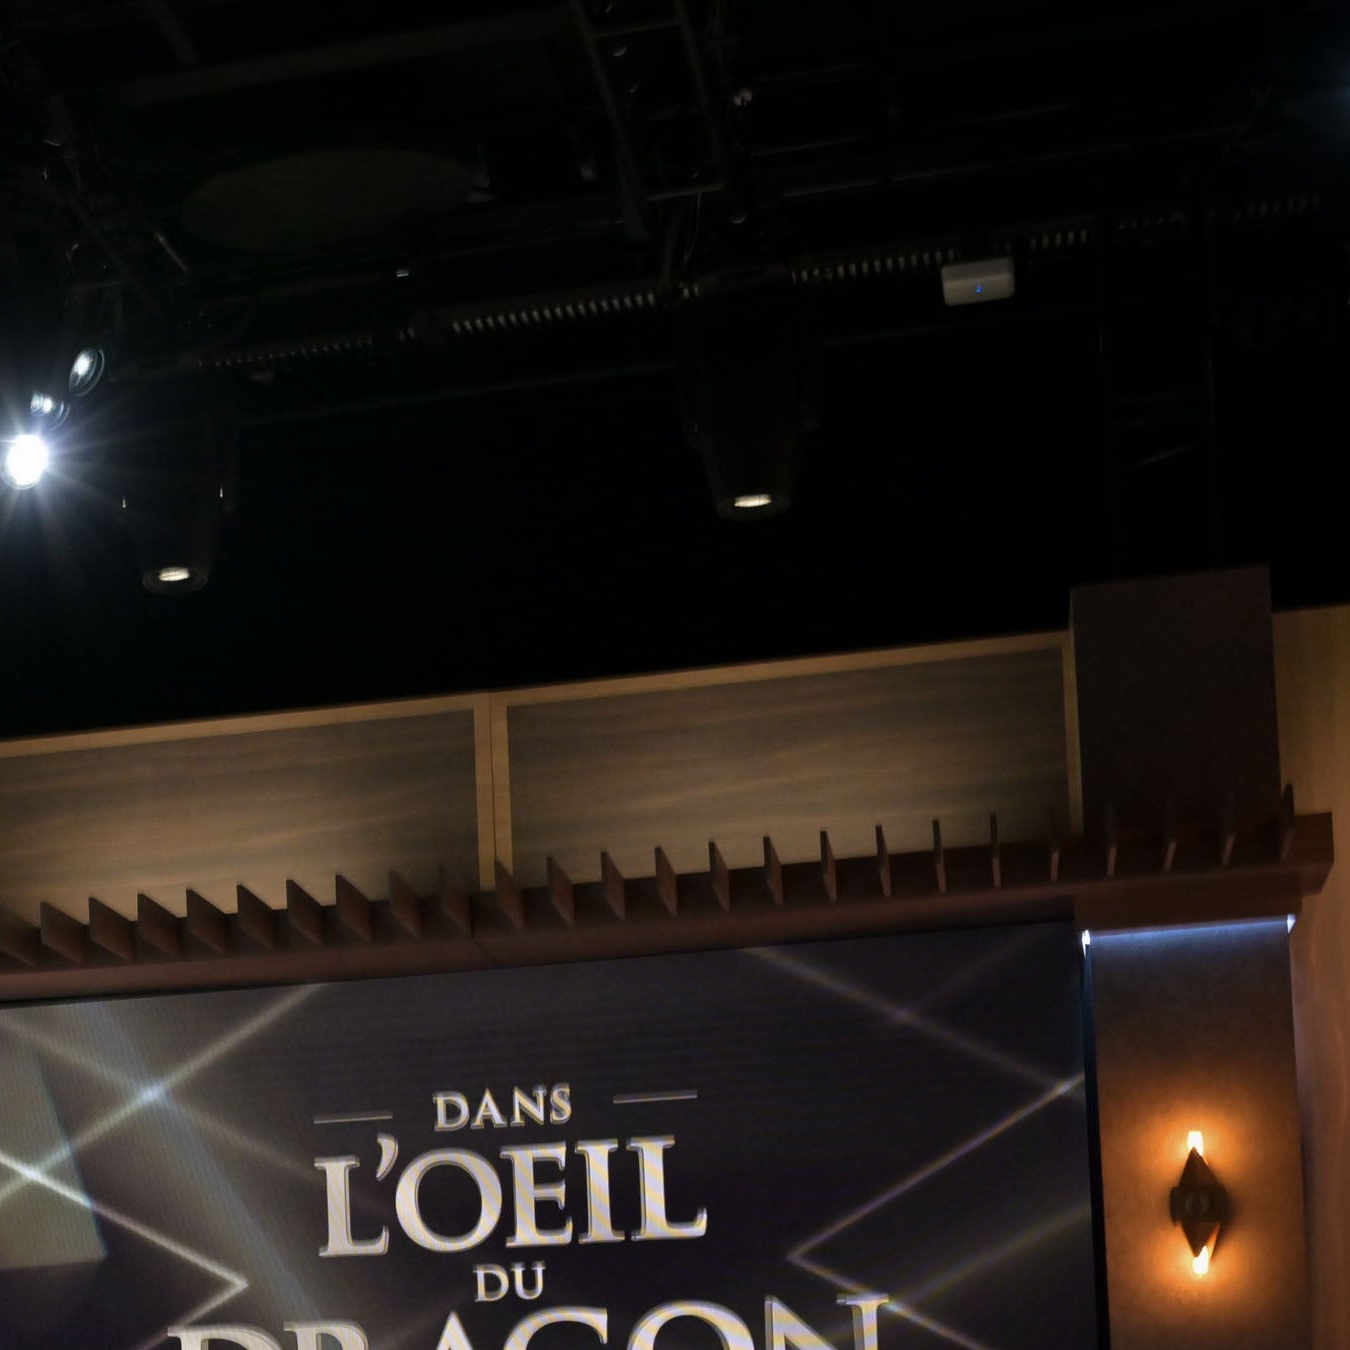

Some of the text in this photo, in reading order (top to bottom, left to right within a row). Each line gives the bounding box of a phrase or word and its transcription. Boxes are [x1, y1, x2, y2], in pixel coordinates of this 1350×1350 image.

[433, 1084, 572, 1132] DANS
[314, 1134, 707, 1257] L'OEIL
[473, 1262, 546, 1302] DU
